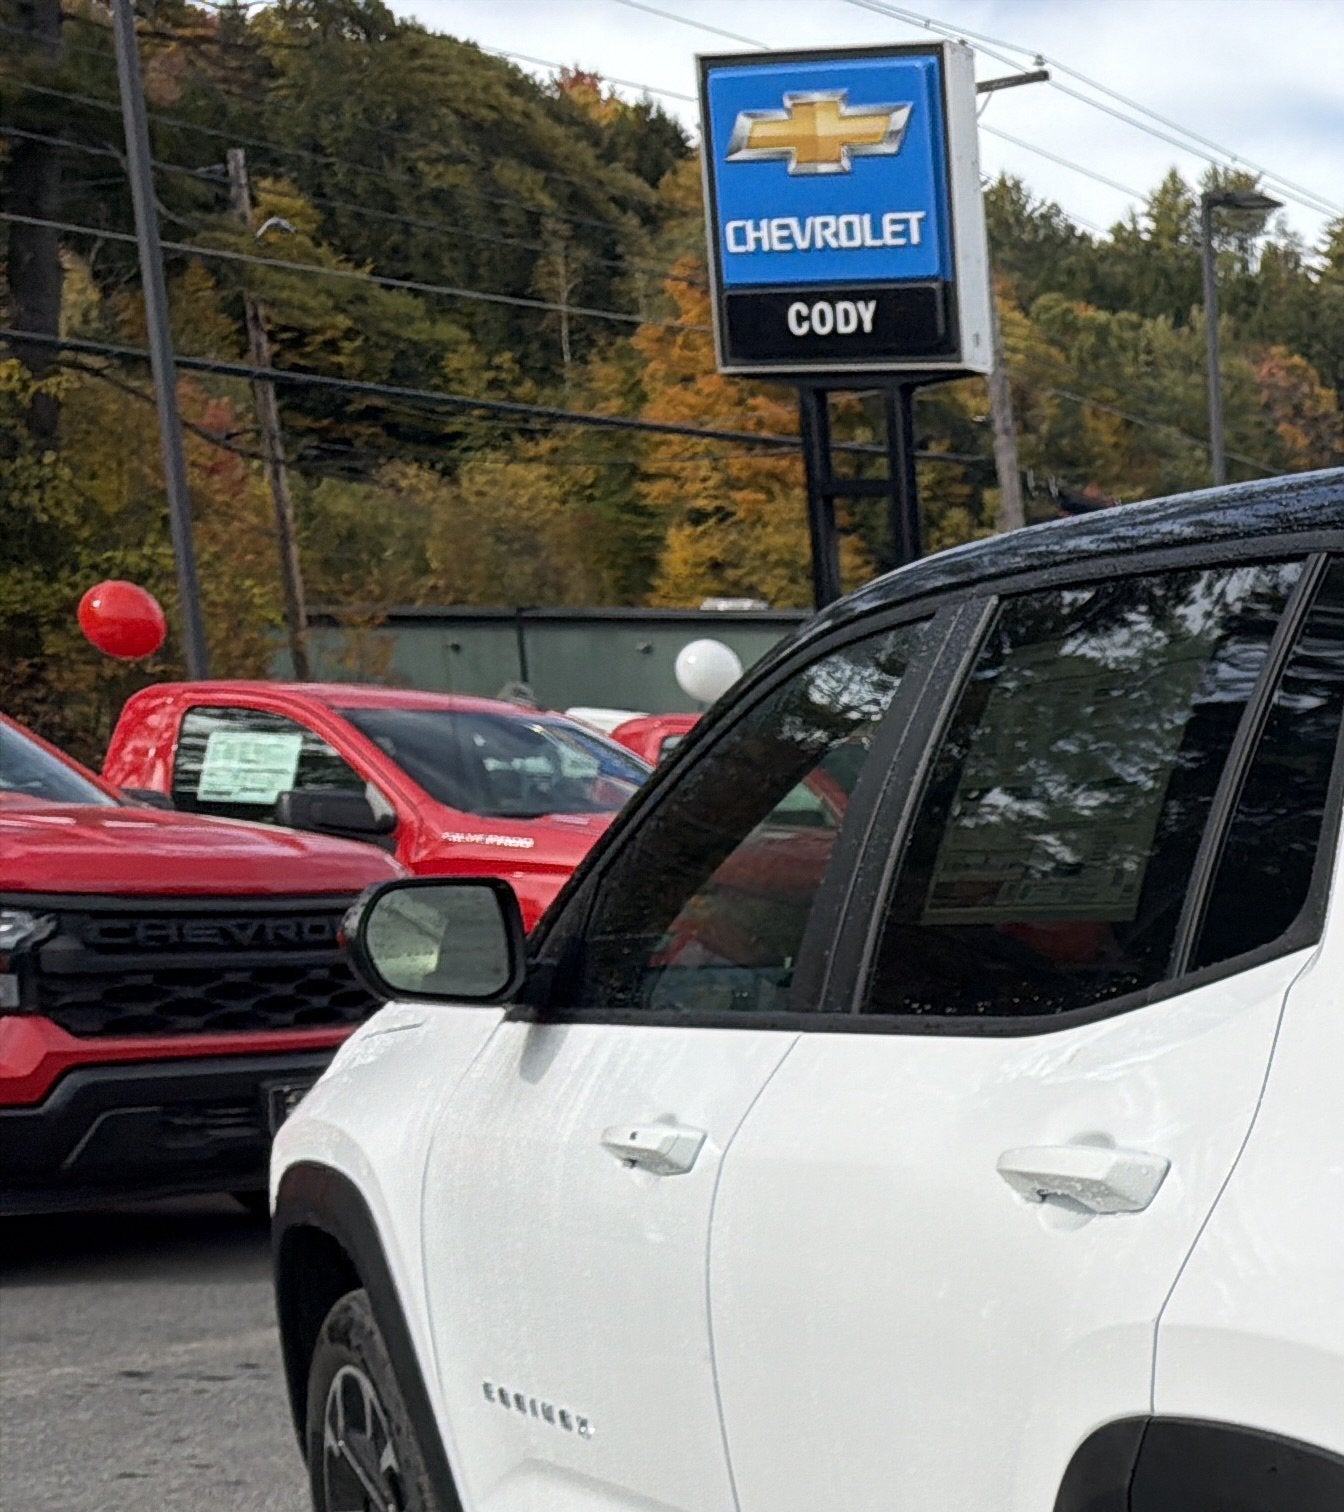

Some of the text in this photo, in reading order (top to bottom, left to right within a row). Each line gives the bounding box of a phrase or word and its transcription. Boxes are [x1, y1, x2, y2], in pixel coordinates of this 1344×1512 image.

[726, 210, 926, 254] CHEVROLET
[787, 300, 877, 337] CODY
[86, 918, 336, 945] CHEVRO
